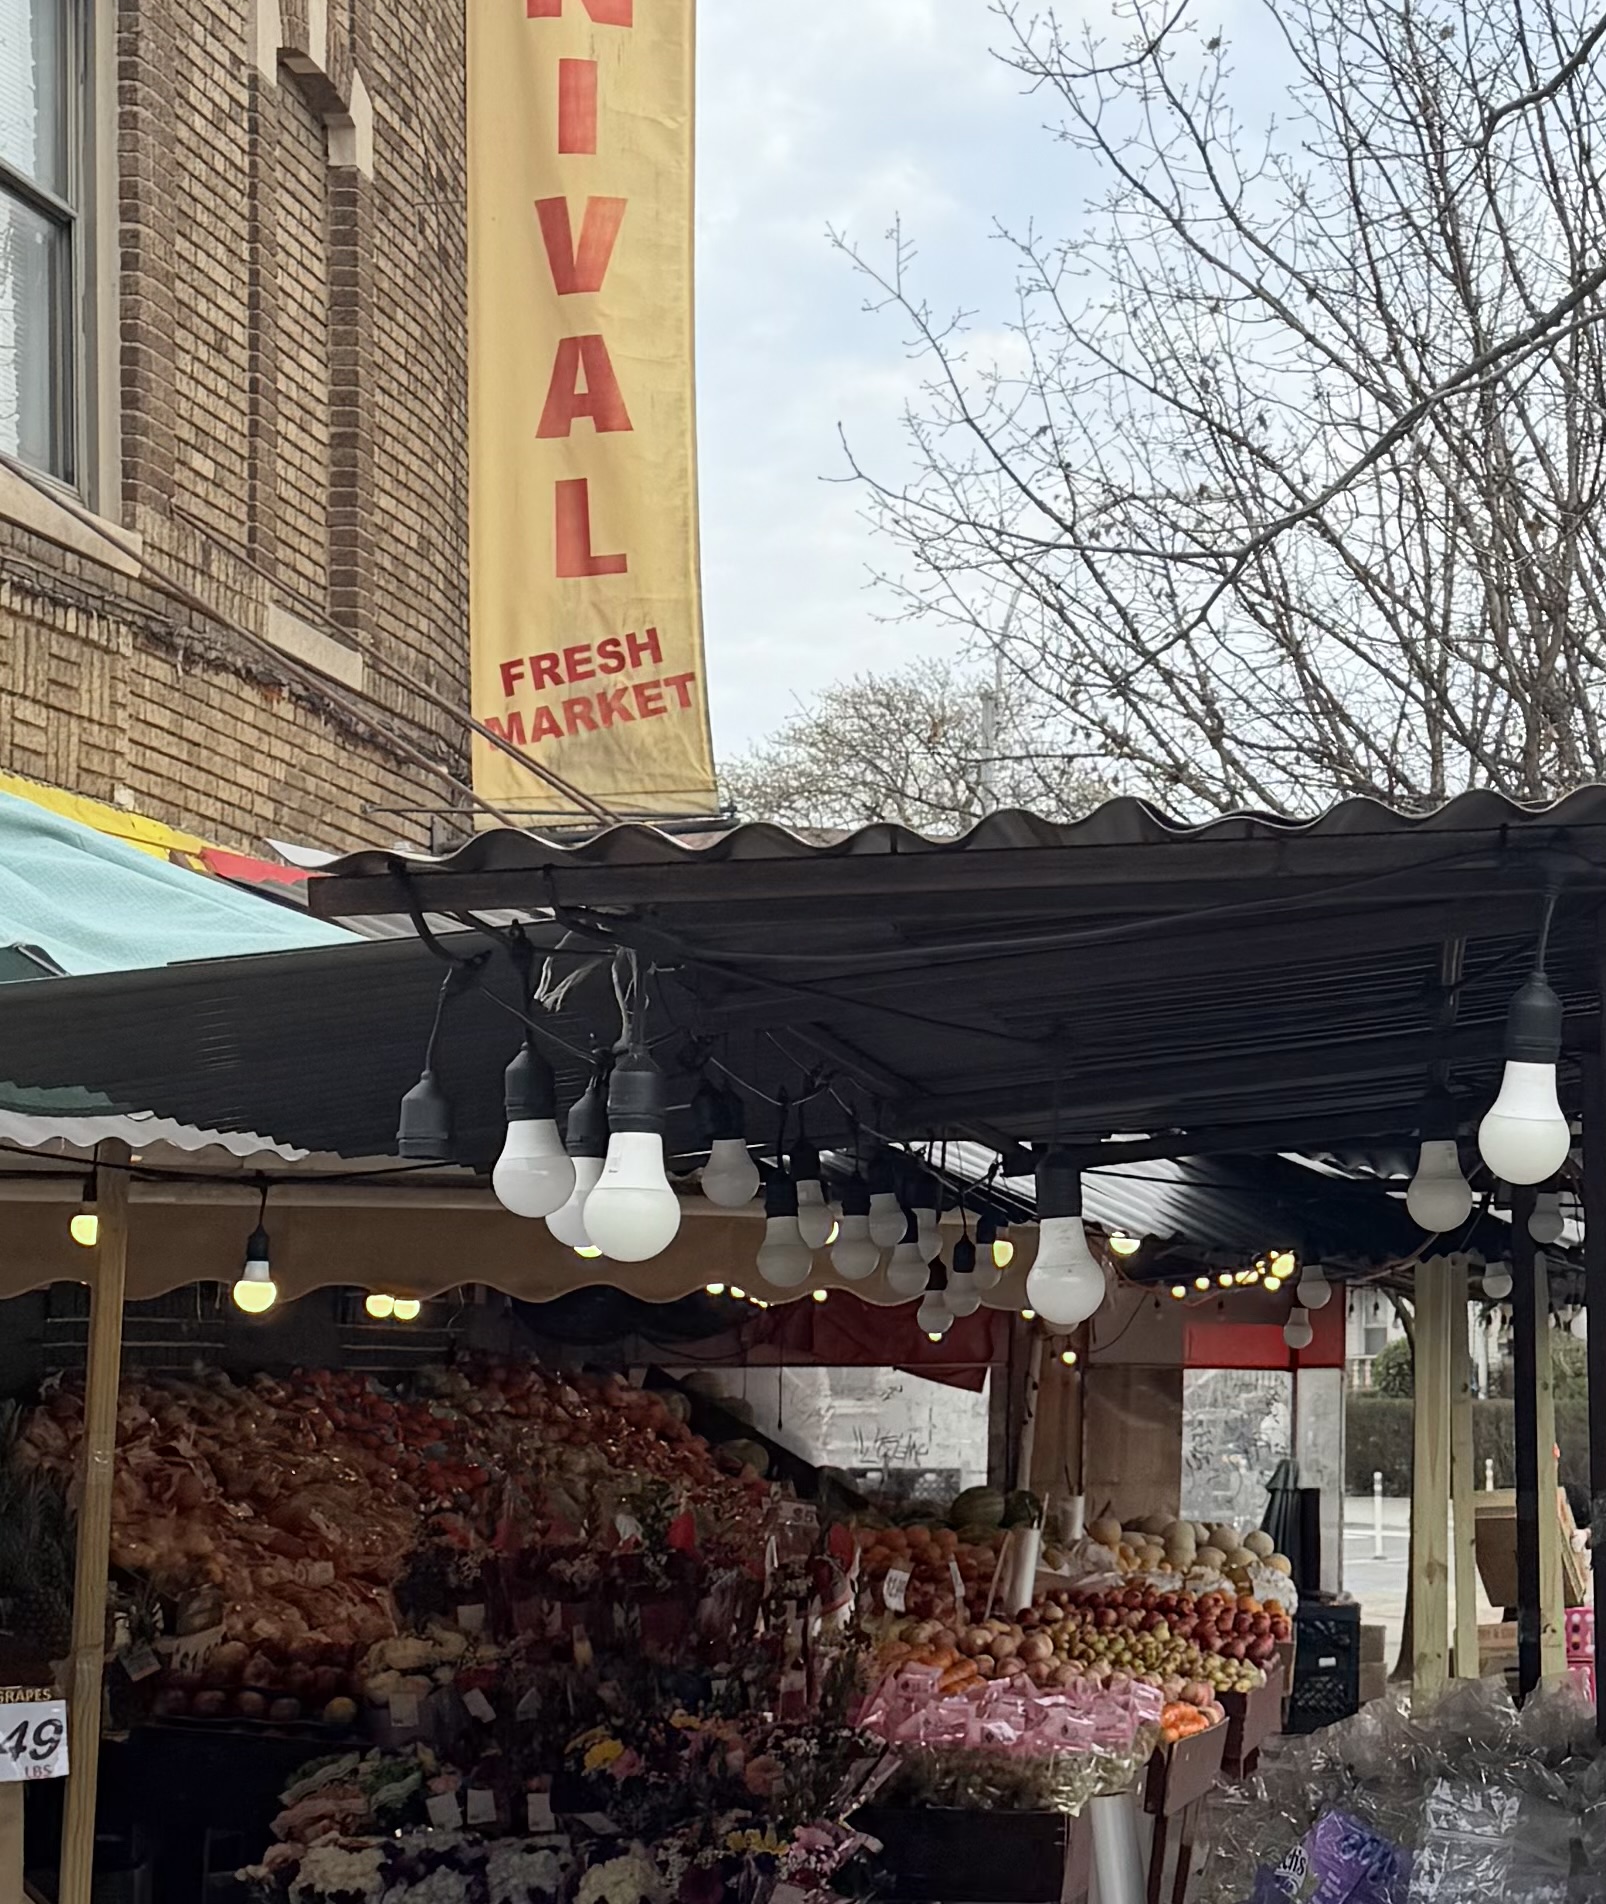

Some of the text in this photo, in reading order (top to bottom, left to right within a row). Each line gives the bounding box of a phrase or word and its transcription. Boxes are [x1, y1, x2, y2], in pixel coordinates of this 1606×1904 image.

[499, 626, 664, 698] FRESH
[484, 671, 697, 752] MARKET
[24, 1763, 53, 1780] LBS
